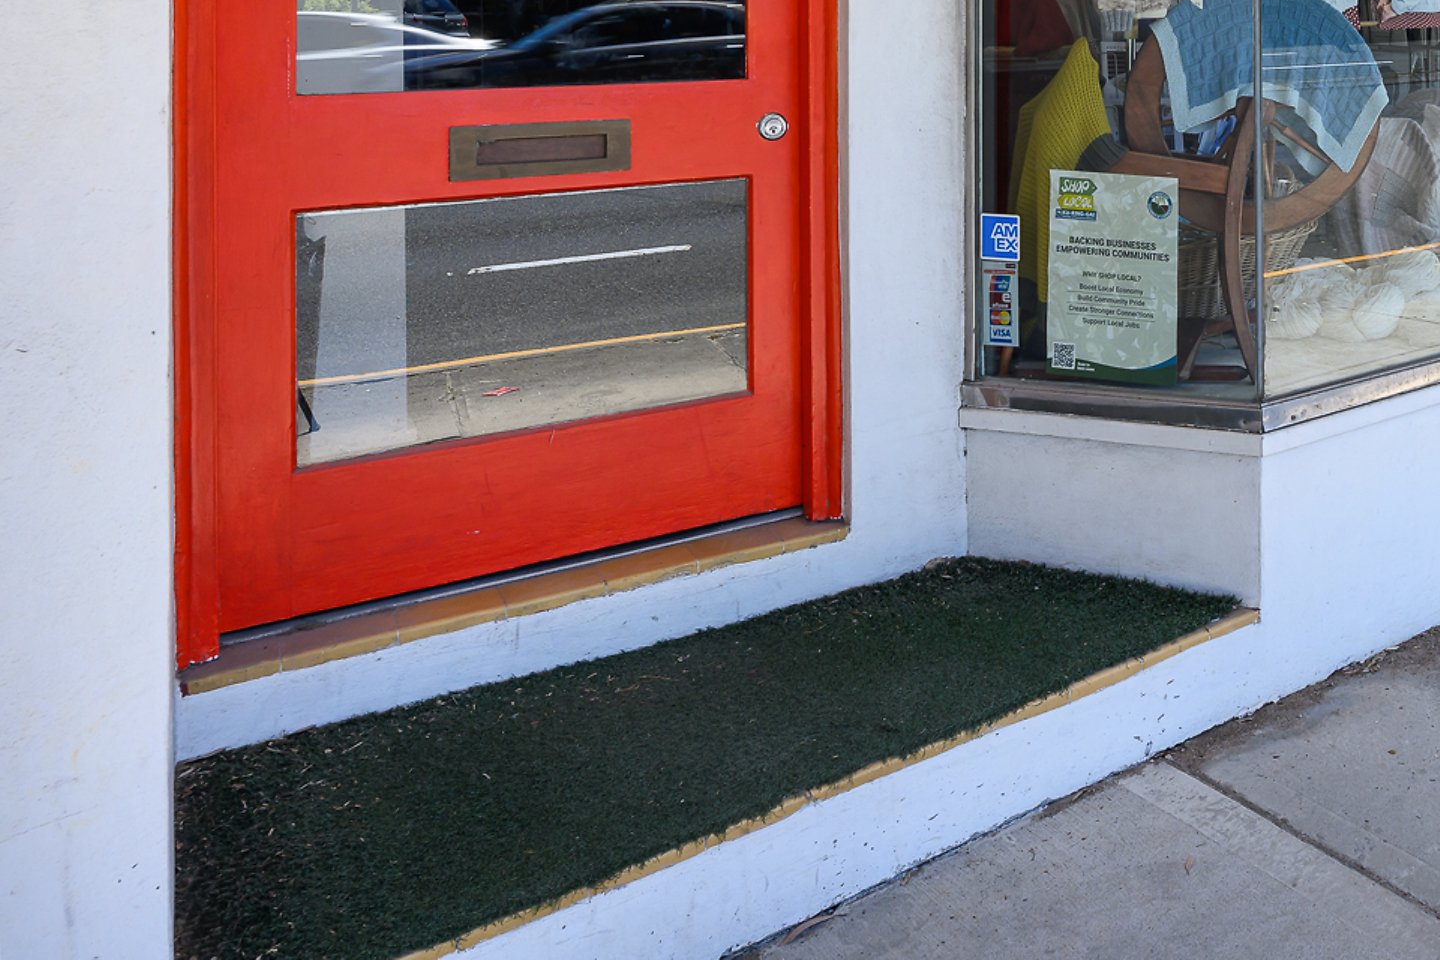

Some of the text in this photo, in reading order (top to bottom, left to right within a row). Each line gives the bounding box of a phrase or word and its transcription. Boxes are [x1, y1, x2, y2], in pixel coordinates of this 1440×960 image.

[1061, 179, 1090, 193] SHOP
[1063, 196, 1092, 208] LOCAL
[991, 223, 1018, 238] AM
[995, 238, 1018, 252] EX
[1069, 236, 1157, 251] BACKING BUSINESSES
[1056, 245, 1170, 262] EMPOWERING COMMUNITIES
[1080, 283, 1143, 295] Boost Local Economy
[1094, 295, 1128, 306] Community
[1068, 304, 1154, 319] Create Stronger Connections
[1082, 317, 1140, 329] Support Local Jobs
[992, 329, 1011, 338] VISA
